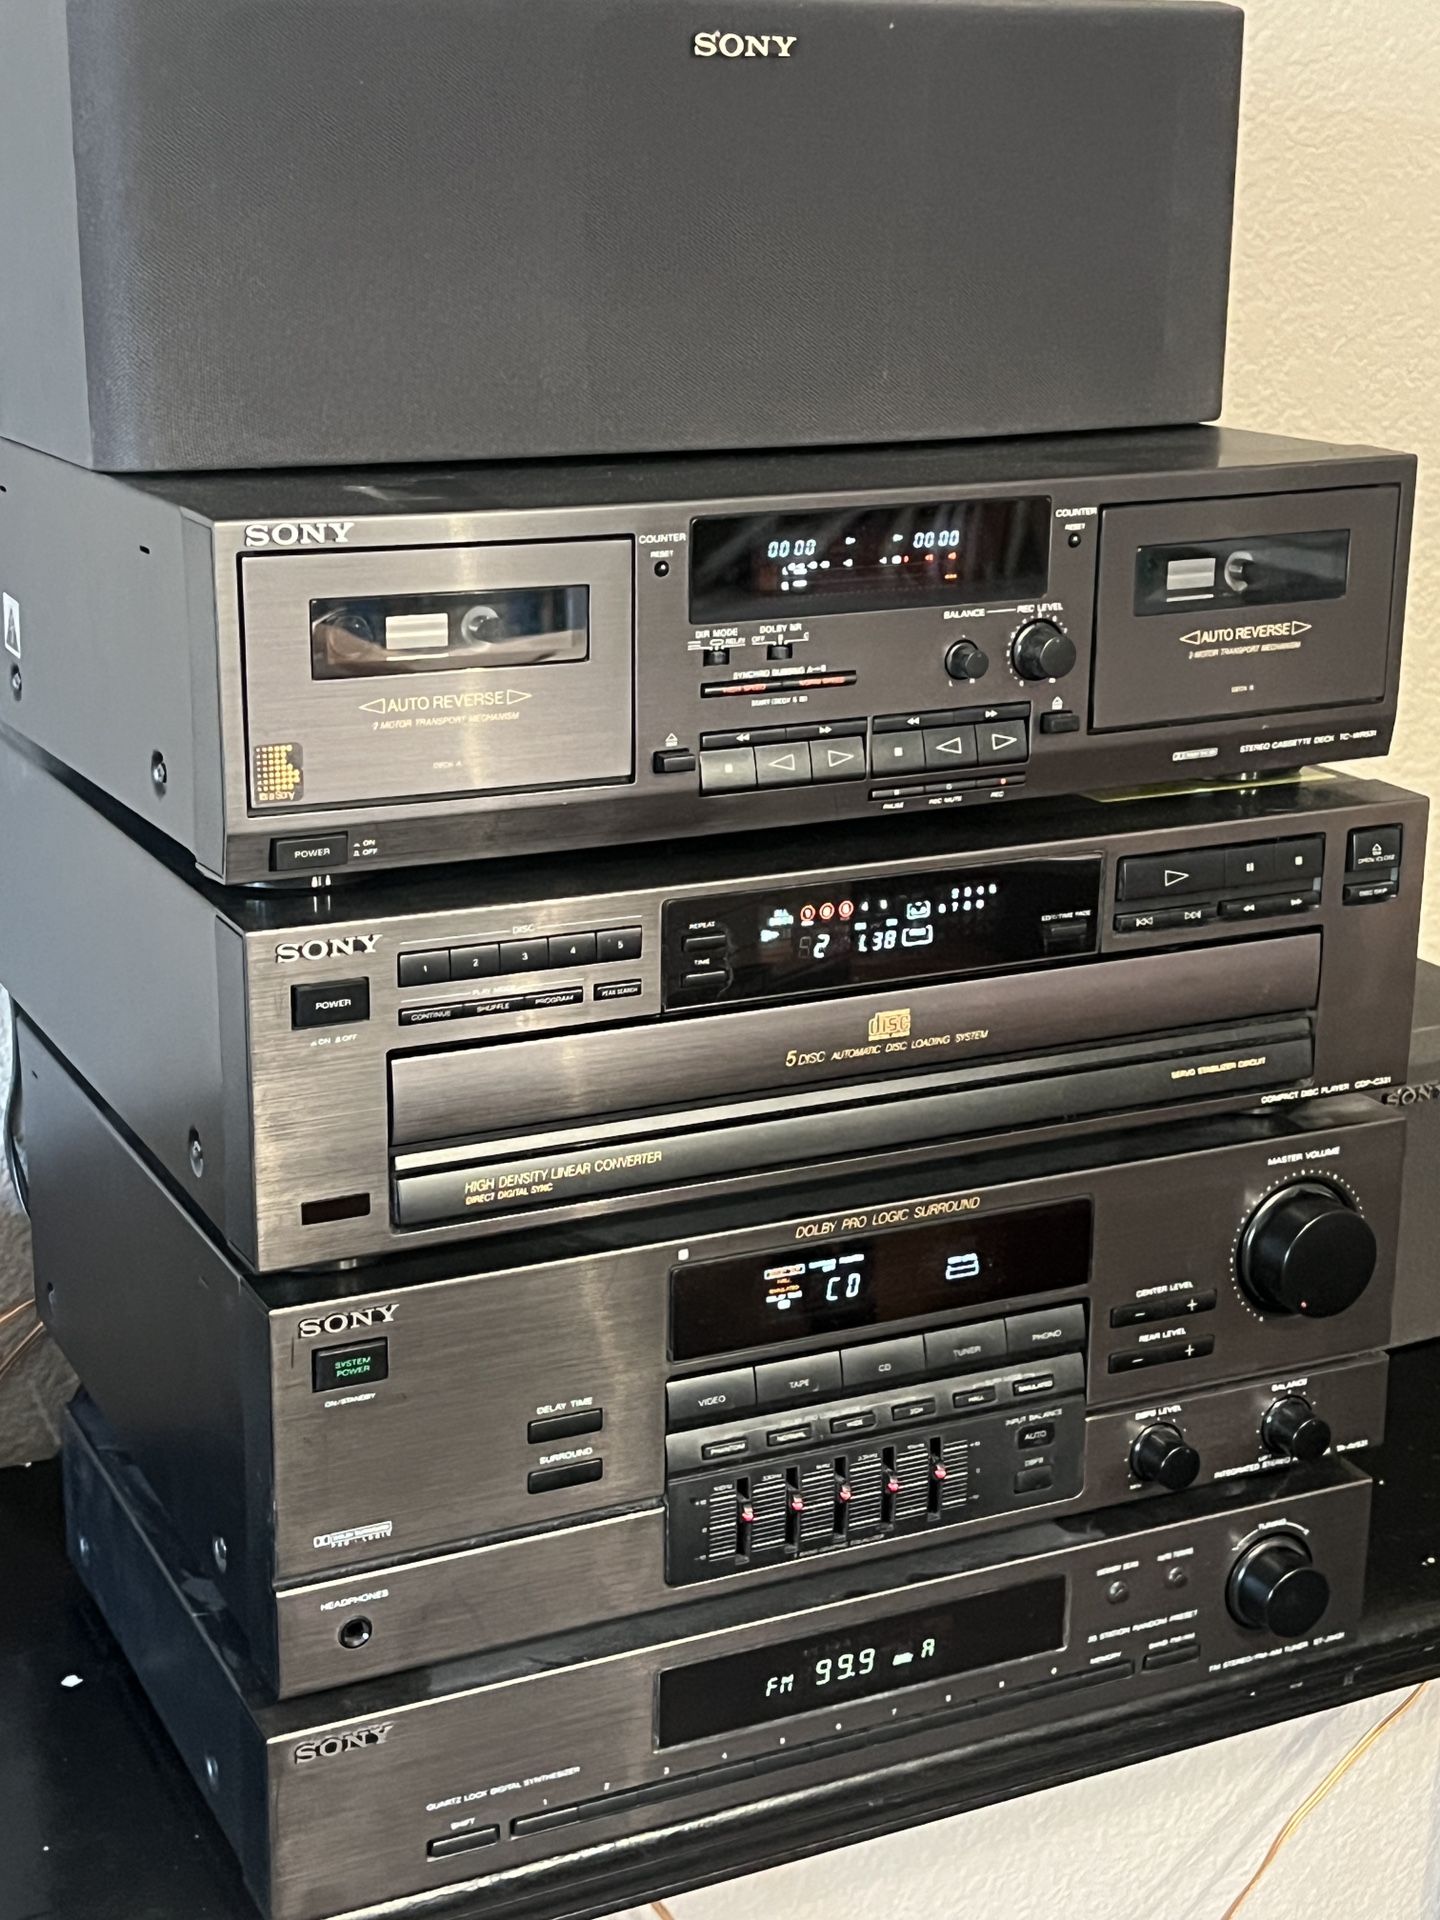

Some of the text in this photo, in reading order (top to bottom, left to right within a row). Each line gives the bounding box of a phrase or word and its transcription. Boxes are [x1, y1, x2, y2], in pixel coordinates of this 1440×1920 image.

[694, 31, 797, 57] SONY
[1055, 506, 1098, 518] COUNTER
[245, 523, 354, 547] SONY
[639, 533, 687, 544] COUNTER
[943, 608, 986, 620] BALANCE
[1016, 602, 1064, 614] REC LEVEL
[712, 627, 738, 638] MODE
[759, 624, 787, 634] DOLBY
[1201, 622, 1291, 643] AUTO REVERSE
[387, 690, 505, 713] AUTO REVERSE
[380, 718, 413, 730] MOTOR
[415, 714, 467, 728] TRANSPORT
[468, 711, 520, 723] MECHANISM
[1239, 742, 1271, 754] STEREO
[1271, 736, 1312, 751] CASSETTE
[1313, 734, 1335, 745] DECK
[362, 839, 376, 847] ON
[294, 847, 331, 859] POWER
[362, 847, 378, 856] OFF
[512, 924, 536, 935] DISC
[276, 934, 384, 964] SONY
[570, 945, 577, 955] 4
[617, 939, 625, 949] 5
[472, 958, 480, 968] 2
[521, 951, 530, 962] 3
[422, 964, 429, 973] 1
[315, 998, 352, 1011] POWER
[535, 994, 575, 1006] PROGRAM
[476, 1003, 511, 1014] SHUFFLE
[411, 1009, 452, 1023] CONTINUE
[318, 1033, 358, 1046] ON OFF
[785, 1049, 797, 1068] 5
[798, 1051, 826, 1067] DISC
[831, 1044, 881, 1061] AUTOMATIC
[885, 1041, 908, 1053] DISC
[911, 1036, 951, 1050] LOADING
[955, 1029, 989, 1044] SYSTEM
[1261, 1090, 1299, 1105] COMPACT
[1300, 1086, 1320, 1098] DISC
[1320, 1082, 1350, 1095] PLAYER
[1267, 1146, 1341, 1166] MASTER VOLUME
[464, 1150, 663, 1195] HIGH DENSITY LINEAR CONVERTER
[465, 1182, 554, 1206] DIRECT DIGITAL SYNC
[795, 1196, 981, 1239] DOLBY PRO LOGIC SURROUND
[1136, 1280, 1194, 1299] CENTER LEVEL
[299, 1304, 400, 1338] SONY
[1032, 1329, 1062, 1341] PHONO
[1162, 1327, 1187, 1338] LEVEL
[953, 1345, 981, 1358] TUNER
[334, 1356, 371, 1370] SYSTEM
[878, 1363, 892, 1373] CD
[336, 1364, 371, 1378] POWER
[788, 1378, 810, 1390] TAPE
[536, 1396, 593, 1415] DELAY TIME
[698, 1394, 726, 1408] VIDEO
[1028, 1407, 1063, 1422] BALANCE
[1024, 1429, 1047, 1441] AUTO
[539, 1446, 593, 1465] SURROUND
[710, 1442, 746, 1456] PHANTOM
[320, 1588, 390, 1612] HEADPHONES
[920, 1637, 936, 1659] A
[765, 1673, 794, 1697] FM
[815, 1647, 876, 1686] 99.9
[294, 1722, 395, 1765] SONY
[426, 1765, 581, 1812] QUARTZ LOCK DIGITAL SYNTHESIZER
